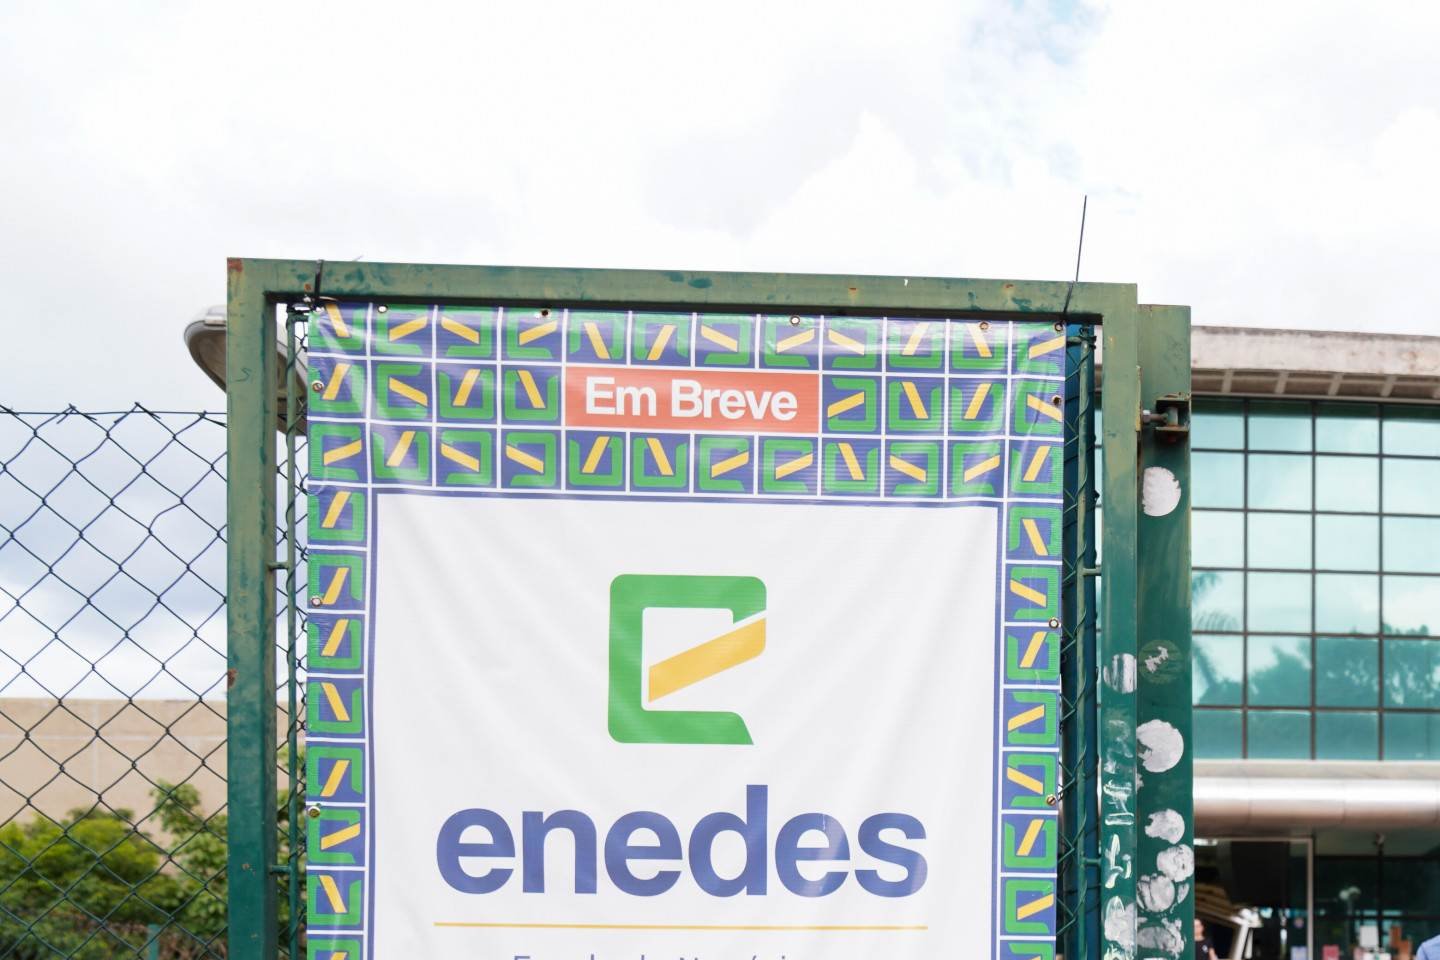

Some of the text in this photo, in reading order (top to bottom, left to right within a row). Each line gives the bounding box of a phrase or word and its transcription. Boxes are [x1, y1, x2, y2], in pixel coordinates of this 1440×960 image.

[586, 376, 798, 421] Em Breve
[436, 784, 928, 898] enedes
